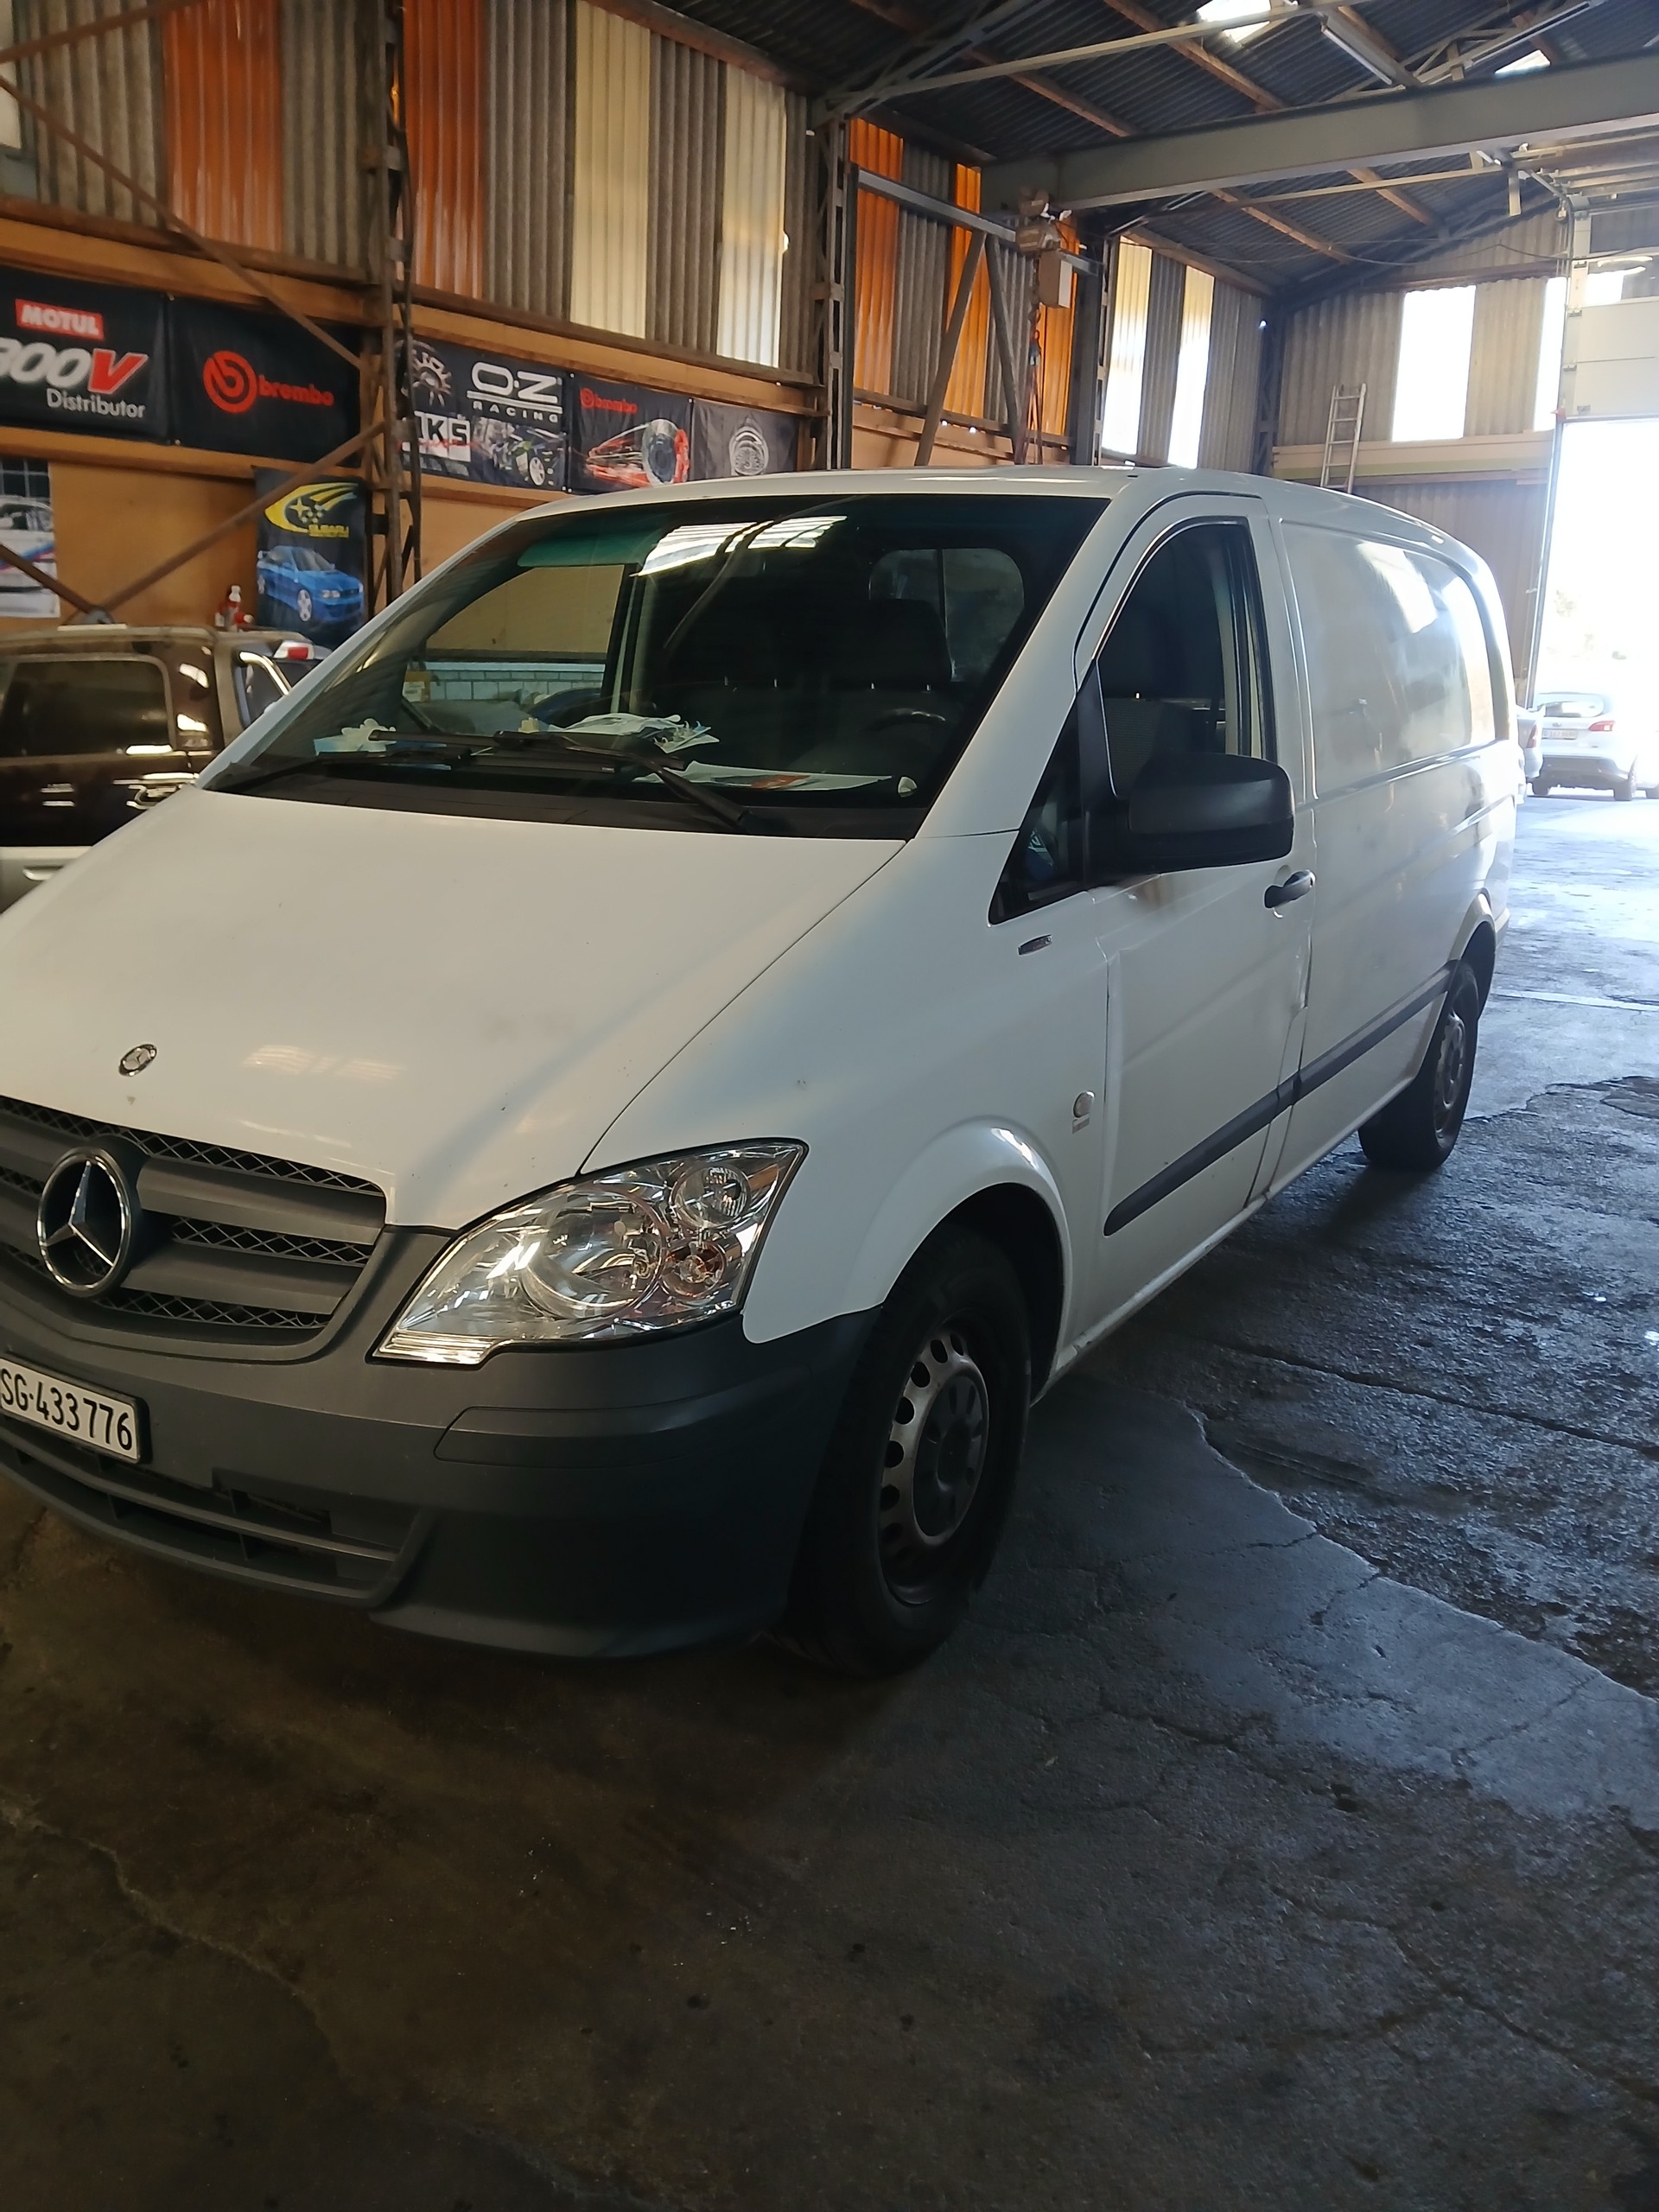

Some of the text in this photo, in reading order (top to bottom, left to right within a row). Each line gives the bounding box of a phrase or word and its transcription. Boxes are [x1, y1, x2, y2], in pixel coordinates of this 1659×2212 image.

[22, 305, 99, 335] MOTUL
[47, 389, 145, 418] Distributor
[259, 376, 334, 406] brembo
[473, 401, 559, 423] RACING
